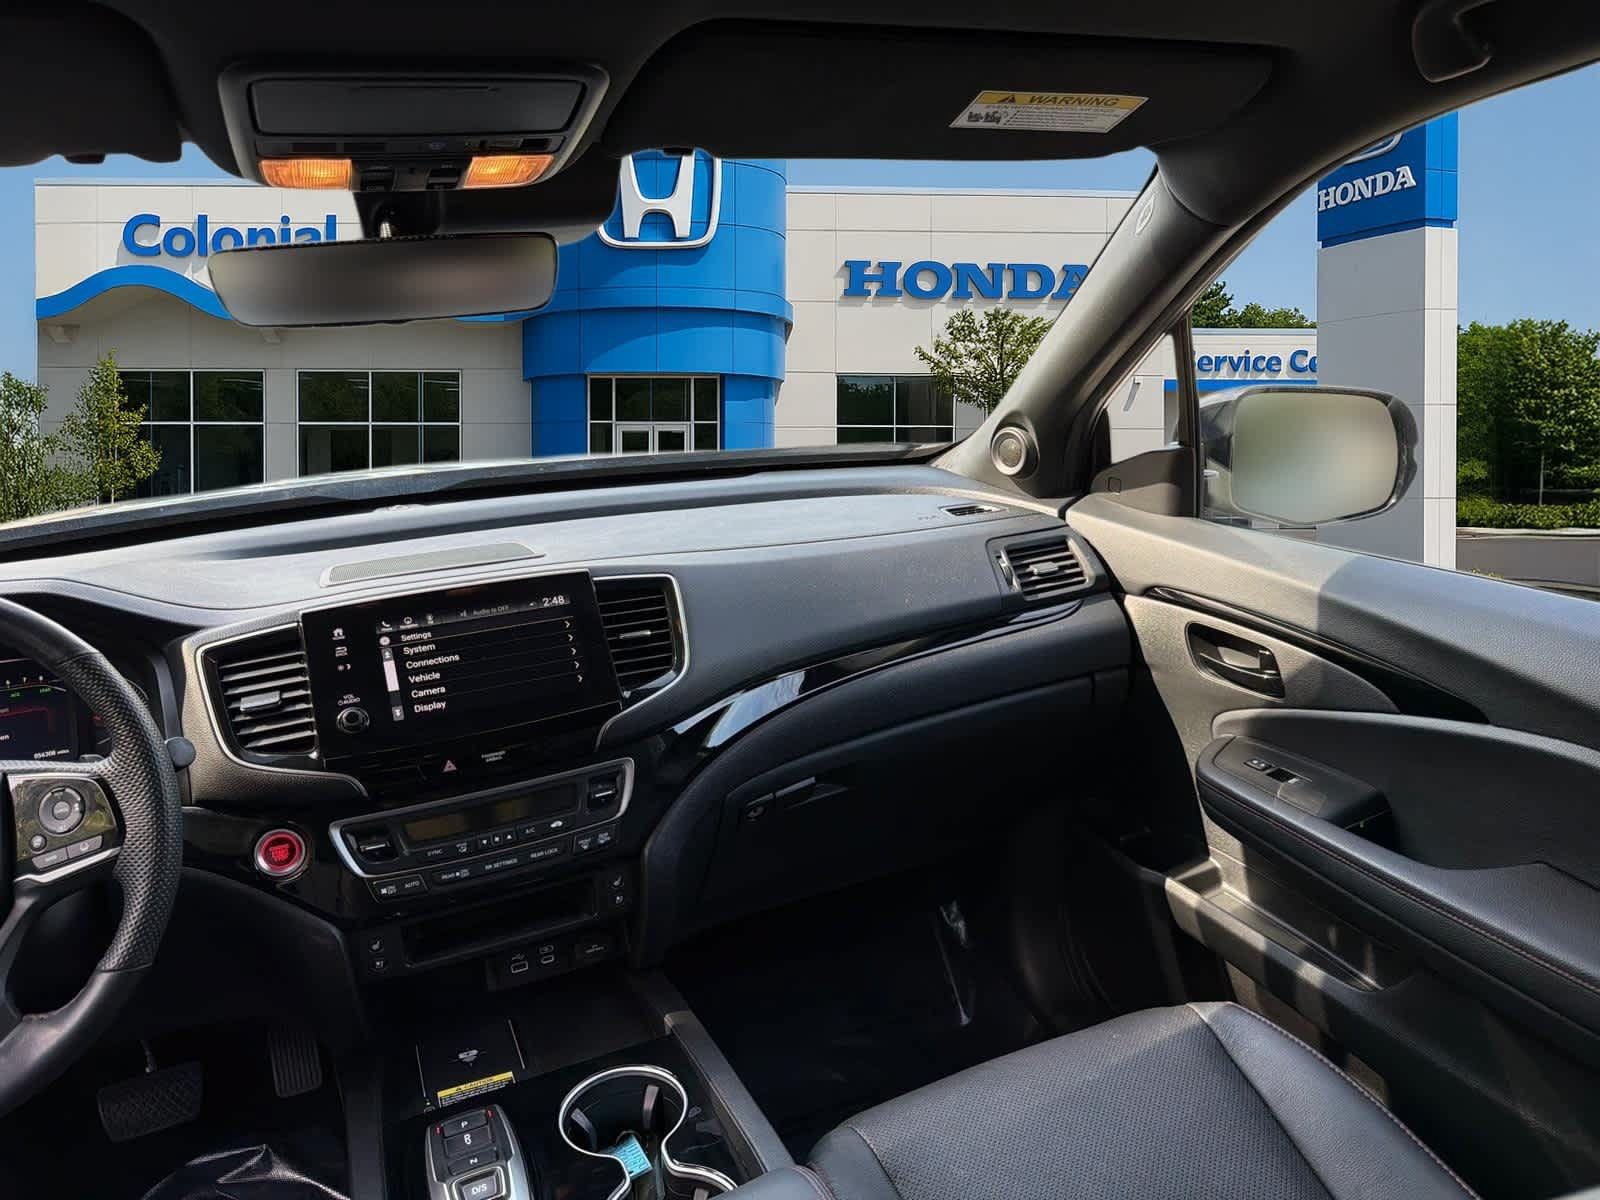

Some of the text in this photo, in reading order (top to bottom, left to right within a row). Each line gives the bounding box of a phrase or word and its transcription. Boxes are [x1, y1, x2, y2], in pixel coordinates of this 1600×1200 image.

[1028, 95, 1120, 107] WARNING
[1318, 165, 1416, 212] HONDA
[1190, 349, 1282, 373] ervice
[401, 631, 432, 641] Settings
[403, 643, 436, 655] System
[406, 654, 460, 669] Connections
[408, 671, 441, 683] Vehicle
[411, 686, 446, 698] Camera
[414, 701, 447, 713] Display
[461, 1120, 469, 1129] P
